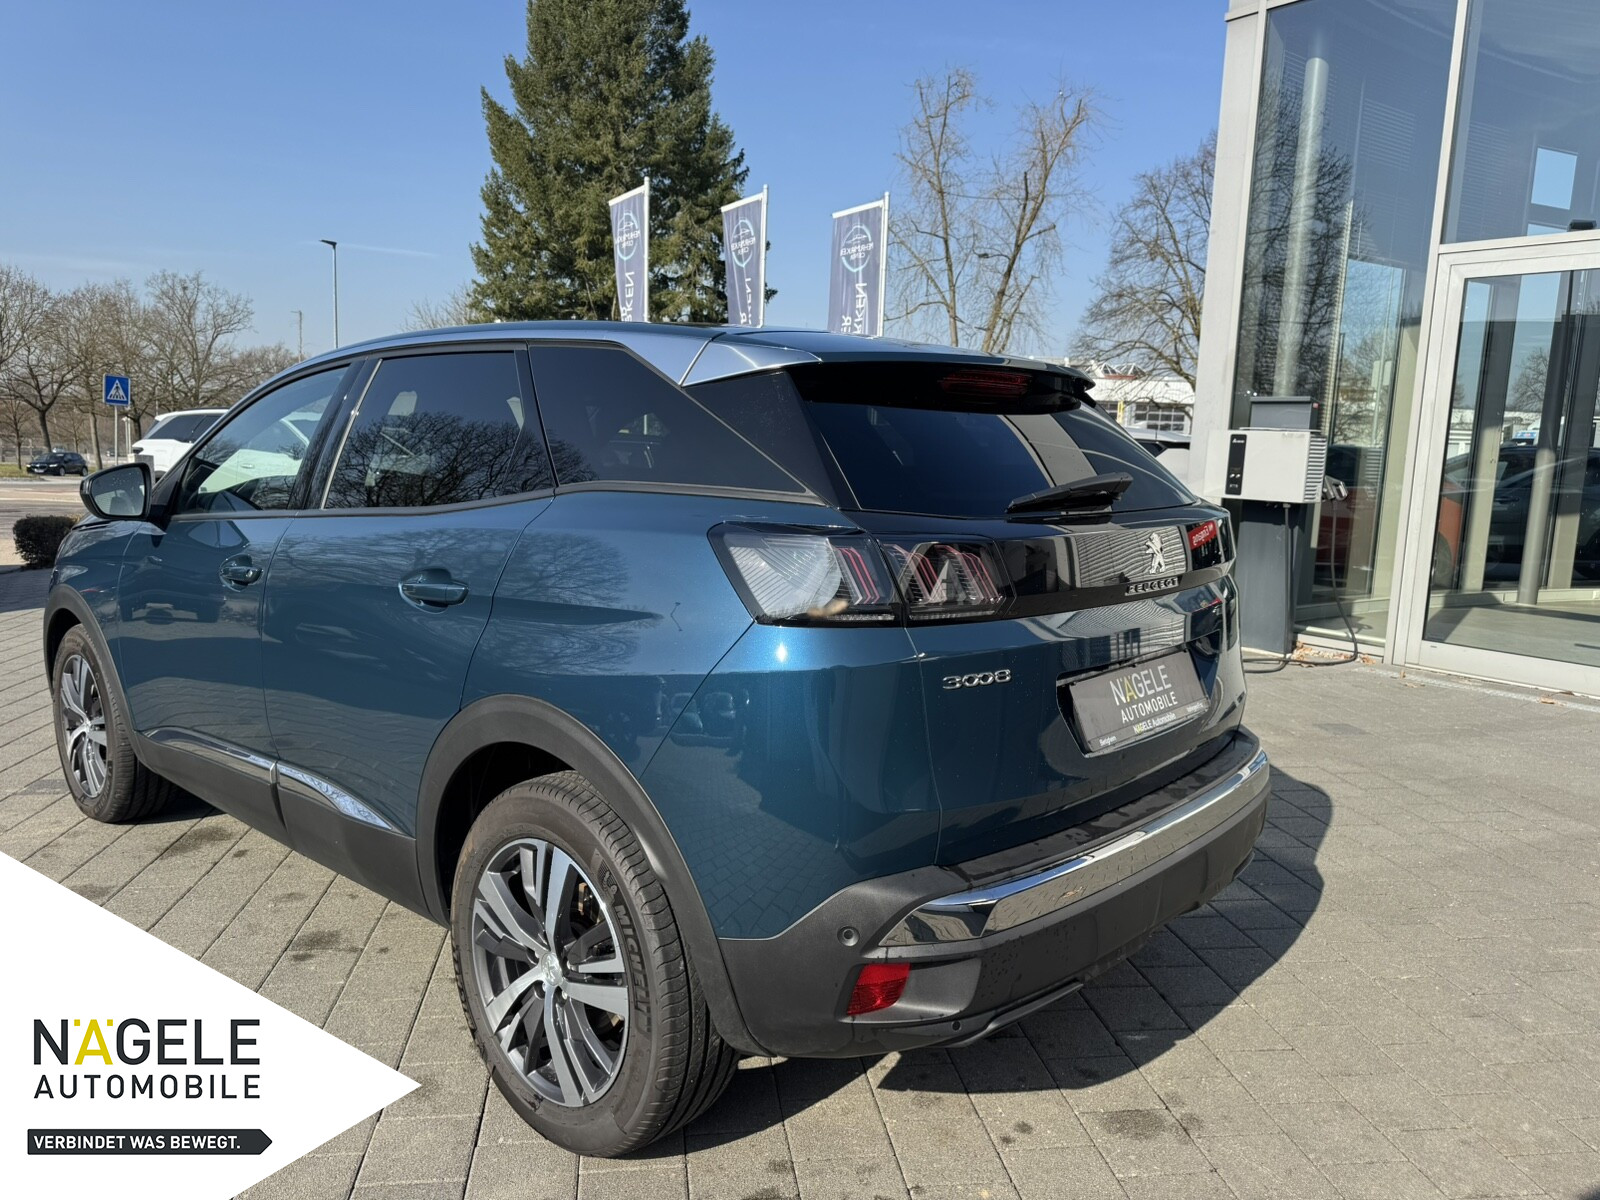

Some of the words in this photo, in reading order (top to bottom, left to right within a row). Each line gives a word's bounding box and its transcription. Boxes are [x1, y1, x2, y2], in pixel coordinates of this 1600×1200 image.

[1125, 576, 1179, 596] PEUGEOT
[943, 669, 1011, 689] 3008
[1109, 664, 1172, 706] NÄGELE
[1120, 691, 1178, 724] AUTOMOBILE
